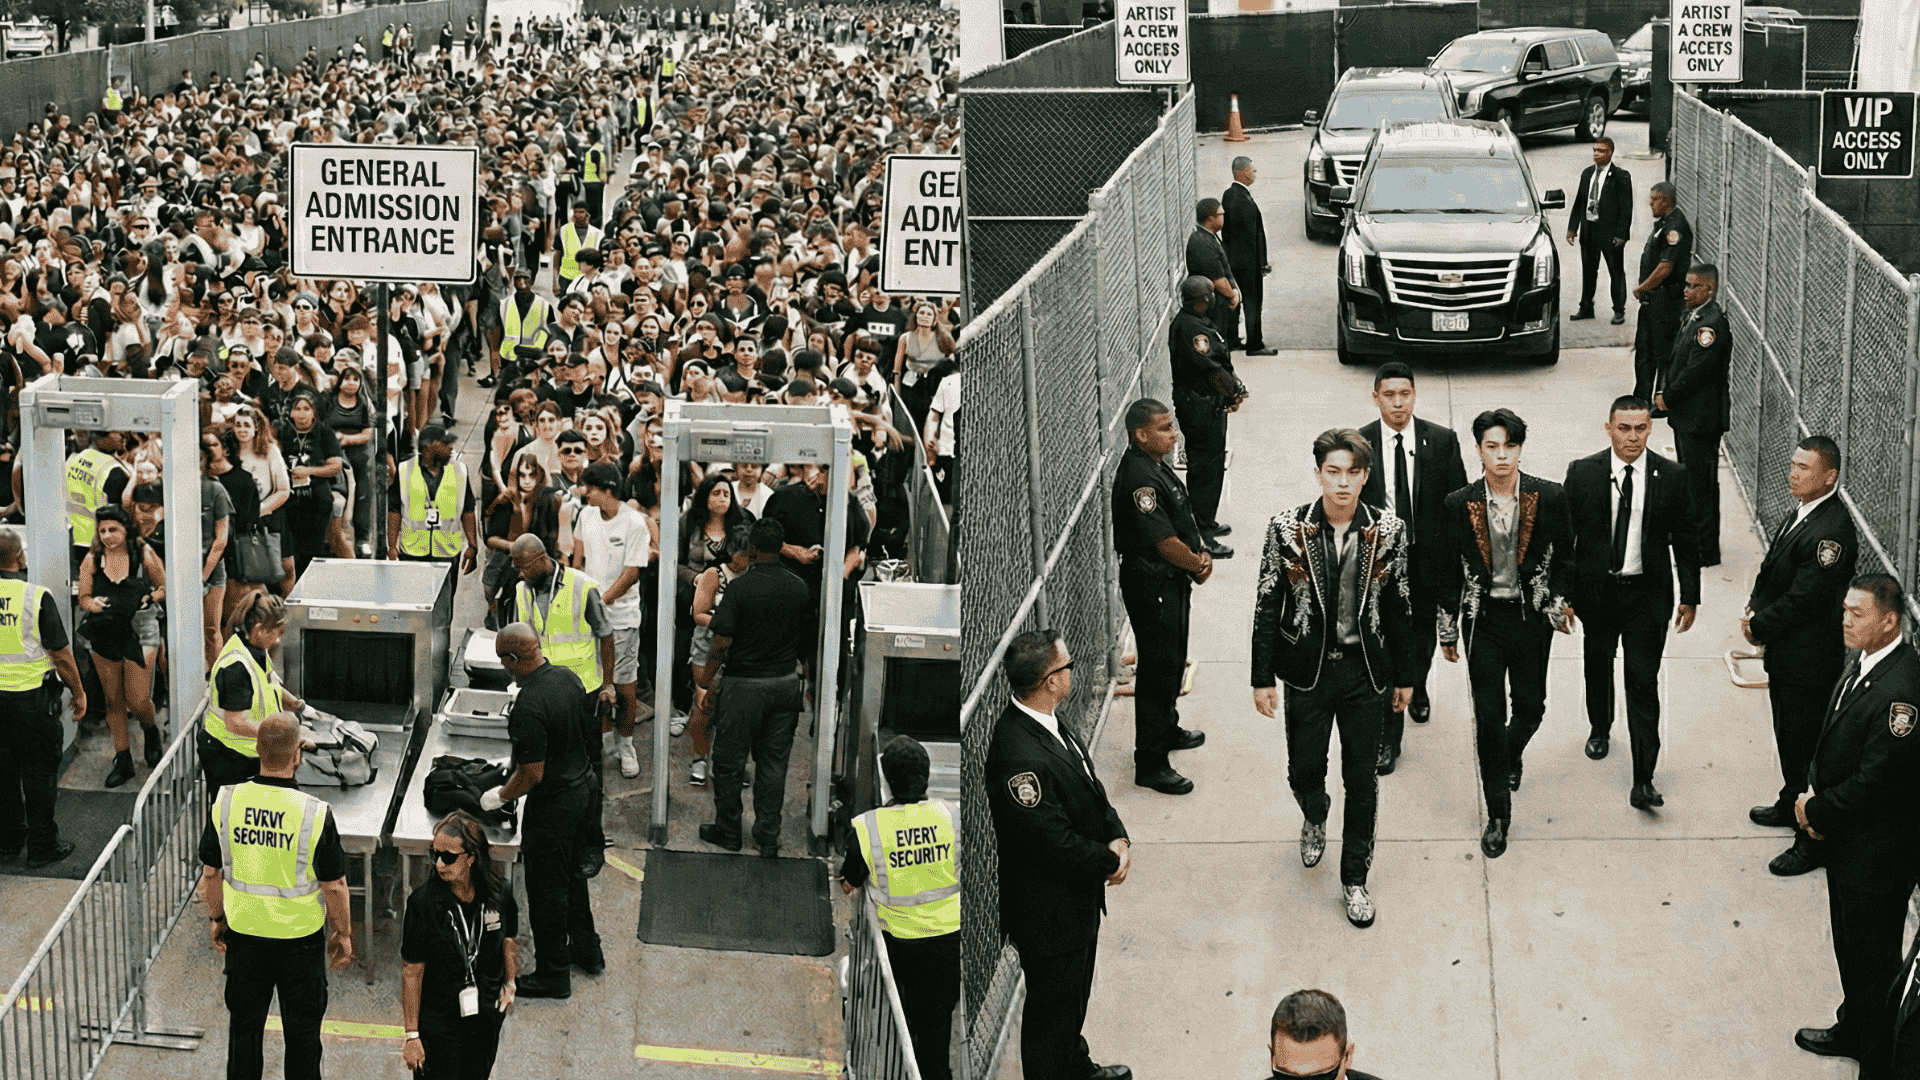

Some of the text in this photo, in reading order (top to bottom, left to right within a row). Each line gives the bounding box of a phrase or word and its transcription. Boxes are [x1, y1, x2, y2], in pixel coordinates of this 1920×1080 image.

[1127, 7, 1174, 20] ARTIST
[1682, 6, 1730, 19] ARTIST
[1124, 25, 1177, 37] A CREW
[1678, 24, 1732, 36] A CREW
[1135, 60, 1171, 73] ONLY
[1845, 98, 1892, 127] VIP
[1833, 132, 1900, 149] ACCESS
[1844, 152, 1888, 169] ONLY
[322, 159, 445, 187] GENERAL
[306, 192, 459, 221] ADMISSION
[312, 226, 454, 254] ENTRANCE
[233, 826, 294, 851] SECURITY
[889, 843, 950, 868] SECURITY
